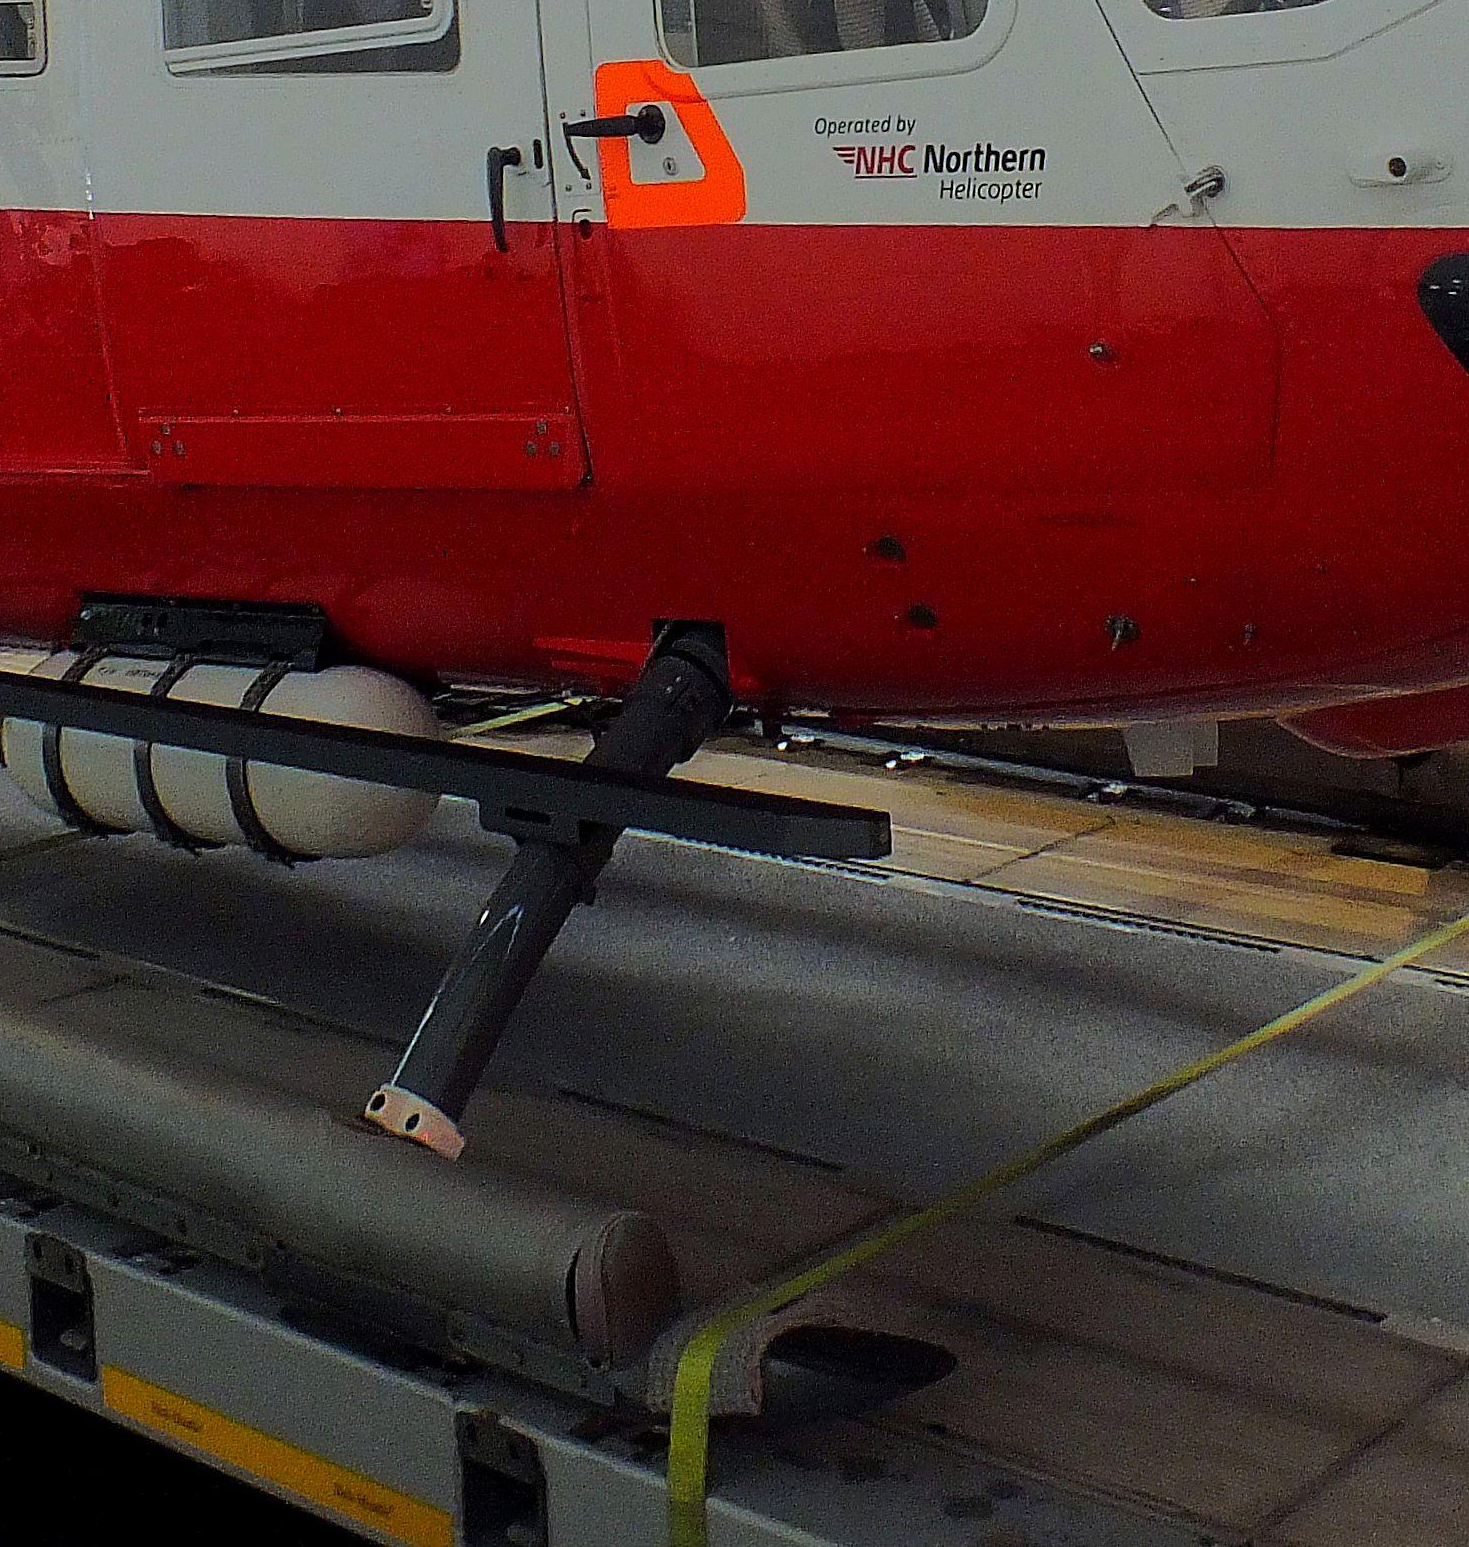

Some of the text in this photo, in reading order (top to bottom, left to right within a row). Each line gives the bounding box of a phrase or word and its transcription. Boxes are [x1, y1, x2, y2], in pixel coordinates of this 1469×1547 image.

[814, 114, 917, 138] Operated by
[854, 142, 1046, 176] NHC Northern
[939, 177, 1043, 204] Helicopter
